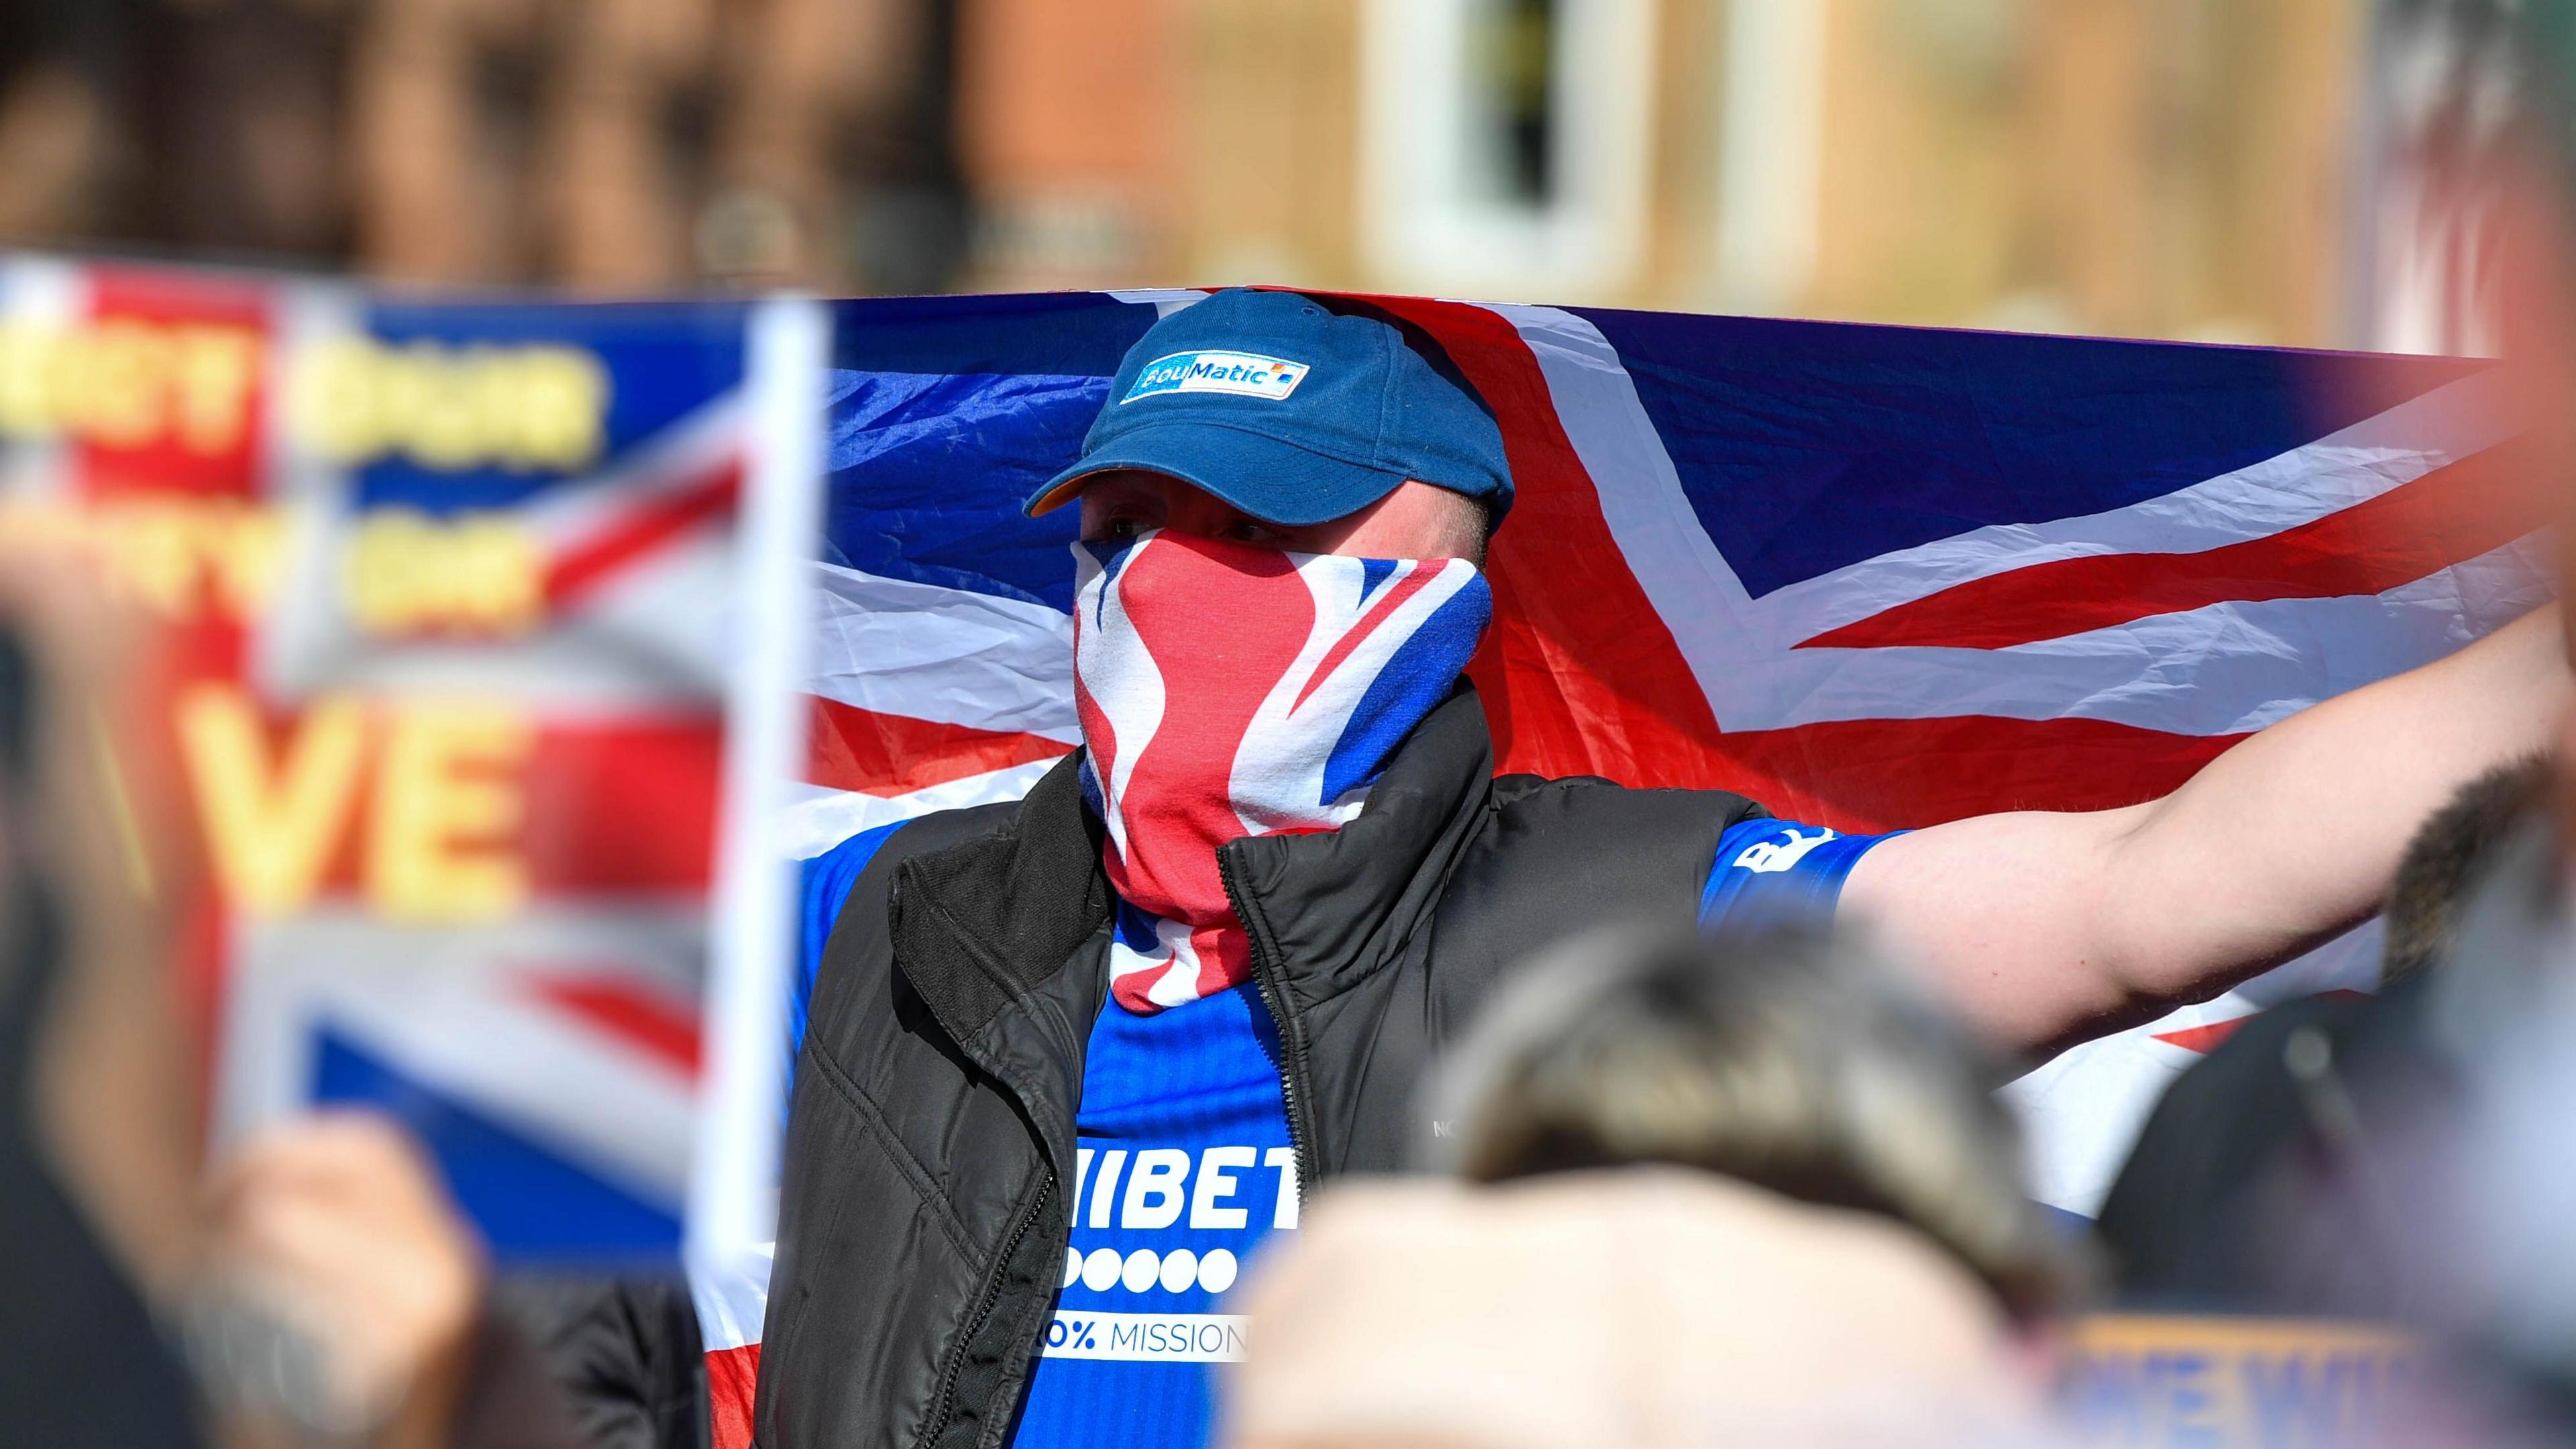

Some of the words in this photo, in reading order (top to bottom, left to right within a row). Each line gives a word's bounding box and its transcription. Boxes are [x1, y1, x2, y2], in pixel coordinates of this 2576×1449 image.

[1142, 362, 1270, 389] BouMatic
[169, 679, 533, 924] VE
[1071, 1146, 1300, 1230] IBET
[1111, 1323, 1249, 1354] MISSION
